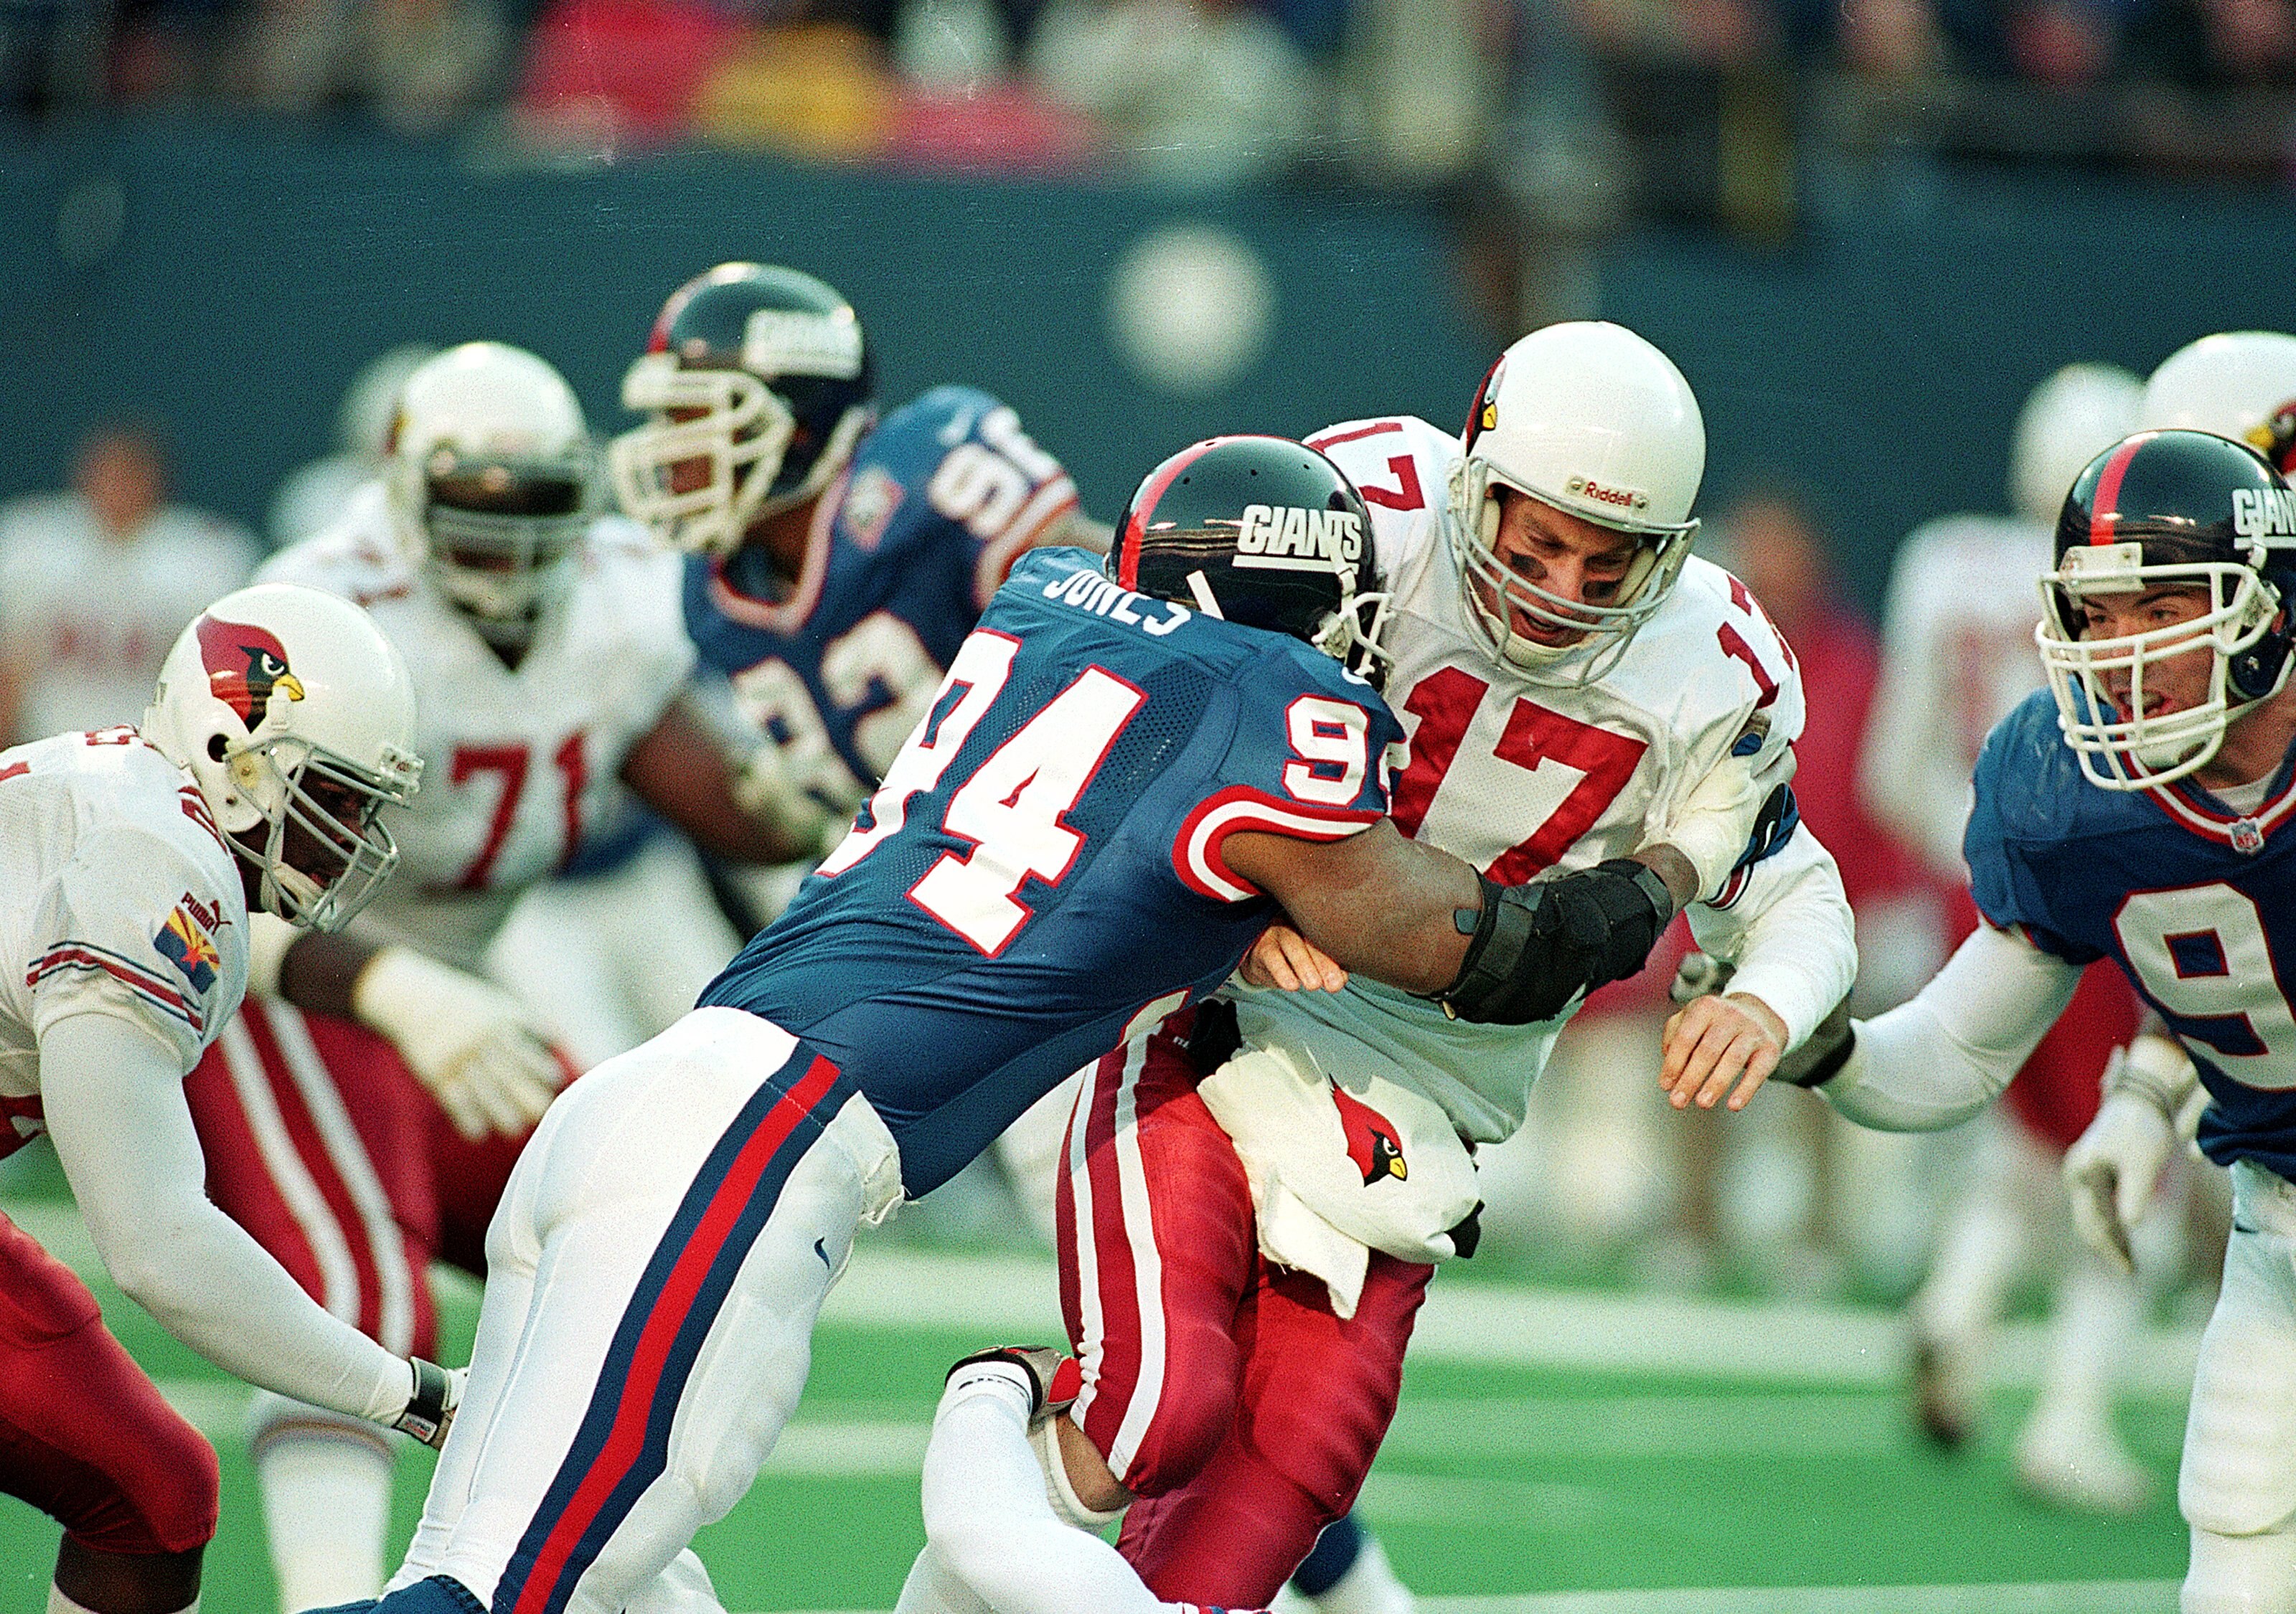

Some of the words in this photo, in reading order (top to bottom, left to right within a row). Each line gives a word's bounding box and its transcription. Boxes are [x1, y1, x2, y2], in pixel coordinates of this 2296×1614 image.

[1301, 422, 1426, 511] 17
[1584, 479, 1633, 506] Riddell
[1237, 504, 1363, 560] GIANTS
[2232, 489, 2296, 535] GIAN
[1043, 570, 1191, 636] JONES
[449, 728, 590, 889] 71
[814, 628, 1149, 959] 94
[1389, 666, 1650, 887] 17
[181, 891, 215, 931] PUMA
